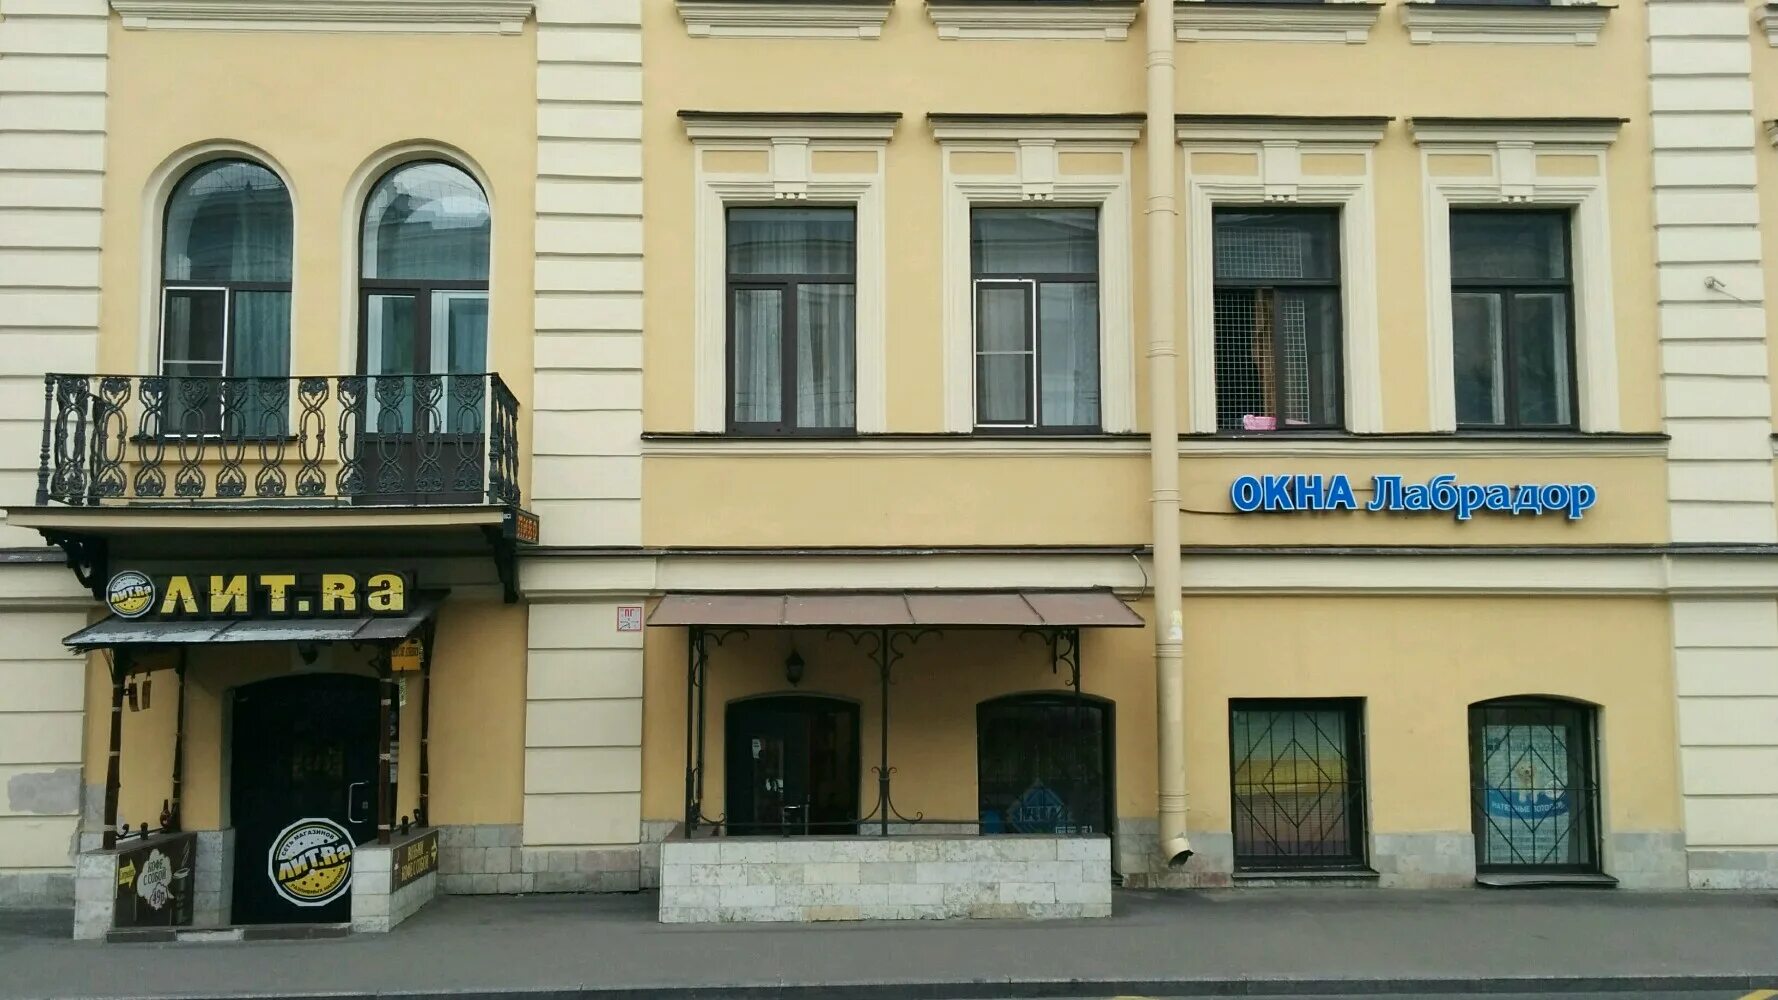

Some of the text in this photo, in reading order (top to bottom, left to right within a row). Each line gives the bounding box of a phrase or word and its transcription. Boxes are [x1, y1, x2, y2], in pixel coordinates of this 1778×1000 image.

[1231, 474, 1597, 519] ОКНА Лабрадор
[294, 828, 335, 841] МАГАЗИНОВ
